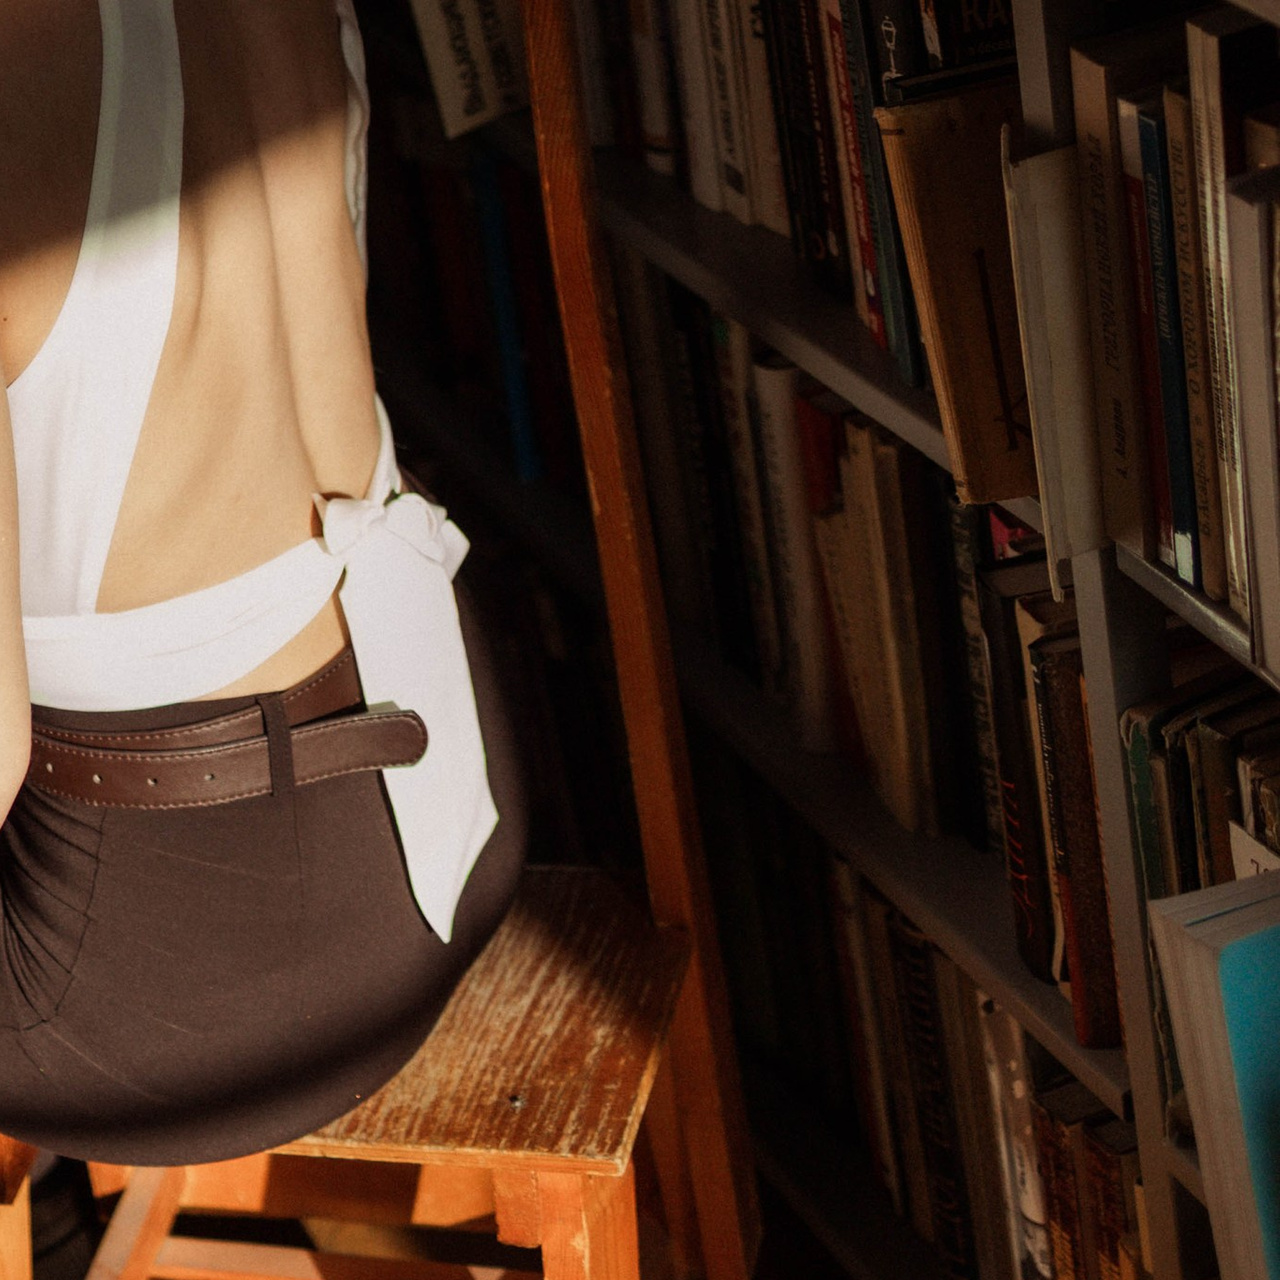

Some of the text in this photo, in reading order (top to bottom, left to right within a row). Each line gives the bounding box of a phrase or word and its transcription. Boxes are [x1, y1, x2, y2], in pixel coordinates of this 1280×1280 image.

[1088, 135, 1107, 206] ХОРАЛ
[1171, 140, 1194, 264] ИСКУССТВЕ
[1096, 208, 1122, 373] ГРЕГОРИАНСКИЙ
[1181, 272, 1201, 369] ХОРОВОМ
[1188, 378, 1201, 396] О
